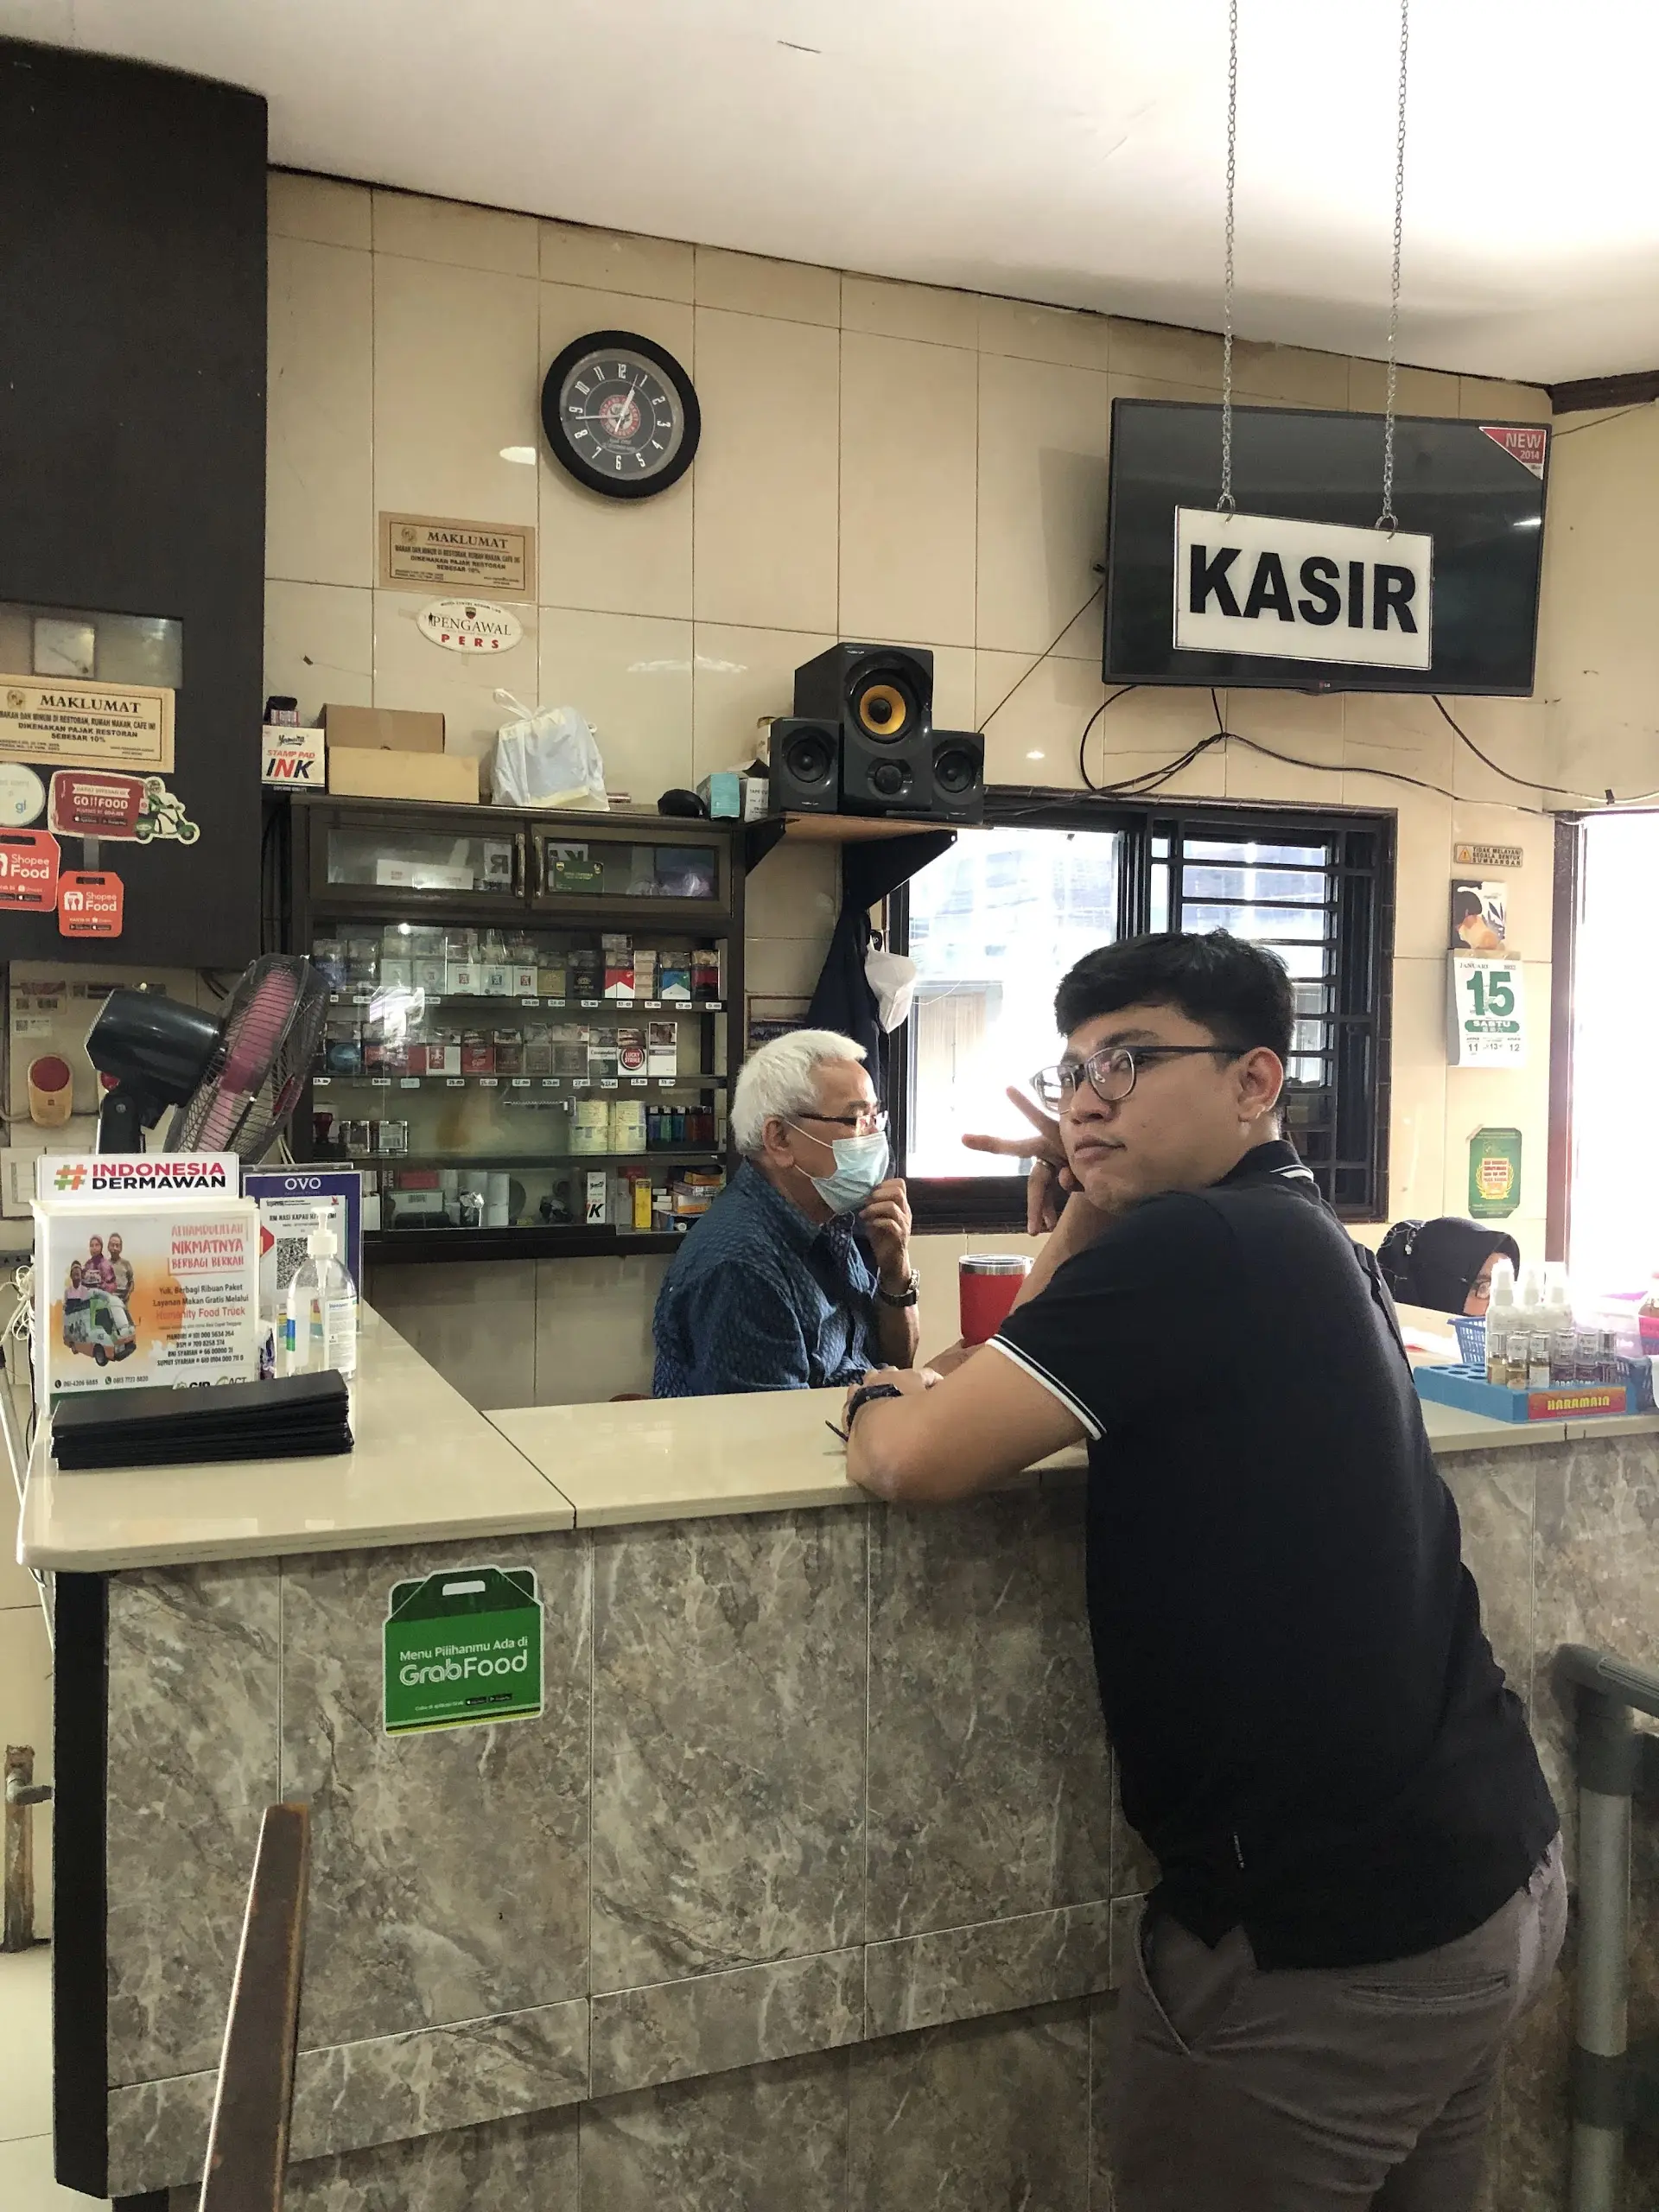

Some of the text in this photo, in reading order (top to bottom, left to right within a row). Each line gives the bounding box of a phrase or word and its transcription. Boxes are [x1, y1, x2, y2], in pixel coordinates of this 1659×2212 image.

[593, 365, 606, 382] 11
[618, 363, 626, 379] 12
[574, 380, 591, 396] 10
[639, 374, 648, 388] 1
[652, 395, 666, 405] 2
[569, 405, 583, 414] 9
[657, 420, 671, 429] 3
[574, 429, 588, 440] 8
[1505, 433, 1541, 448] NEW
[652, 439, 664, 450] 4
[591, 446, 602, 460] 7
[635, 452, 646, 467] 5
[1520, 450, 1540, 461] 2014
[615, 454, 622, 471] 6
[427, 531, 508, 550] MAKLUMAT
[1189, 543, 1419, 633] KASIR
[433, 616, 512, 636] PENGAWAL
[40, 695, 141, 714] MAKLUMAT
[18, 722, 138, 738] DIKENAKAN PAJAK RESTORAN
[51, 733, 87, 741] SEBESAR
[266, 759, 315, 779] INK
[11, 854, 50, 866] Shopee
[10, 864, 50, 880] Food
[86, 892, 118, 901] Shopee
[86, 900, 118, 912] Food
[1466, 970, 1515, 1017] 15
[1468, 1043, 1478, 1052] 11
[92, 1163, 226, 1177] INDONESIA
[92, 1175, 226, 1190] DERMAWAN
[284, 1178, 321, 1191] OVO
[172, 1238, 244, 1255] NIKMATNYA
[172, 1255, 244, 1269] BERBAGI BERKAH
[175, 1286, 200, 1294] Berbagi
[152, 1299, 181, 1307] Layanan
[199, 1307, 219, 1318] Food
[222, 1306, 245, 1316] Truck
[1547, 1395, 1610, 1410] HARAMAIN
[399, 1636, 528, 1661] Menu Pilihanmu Ada di
[399, 1649, 528, 1686] GrabFood
